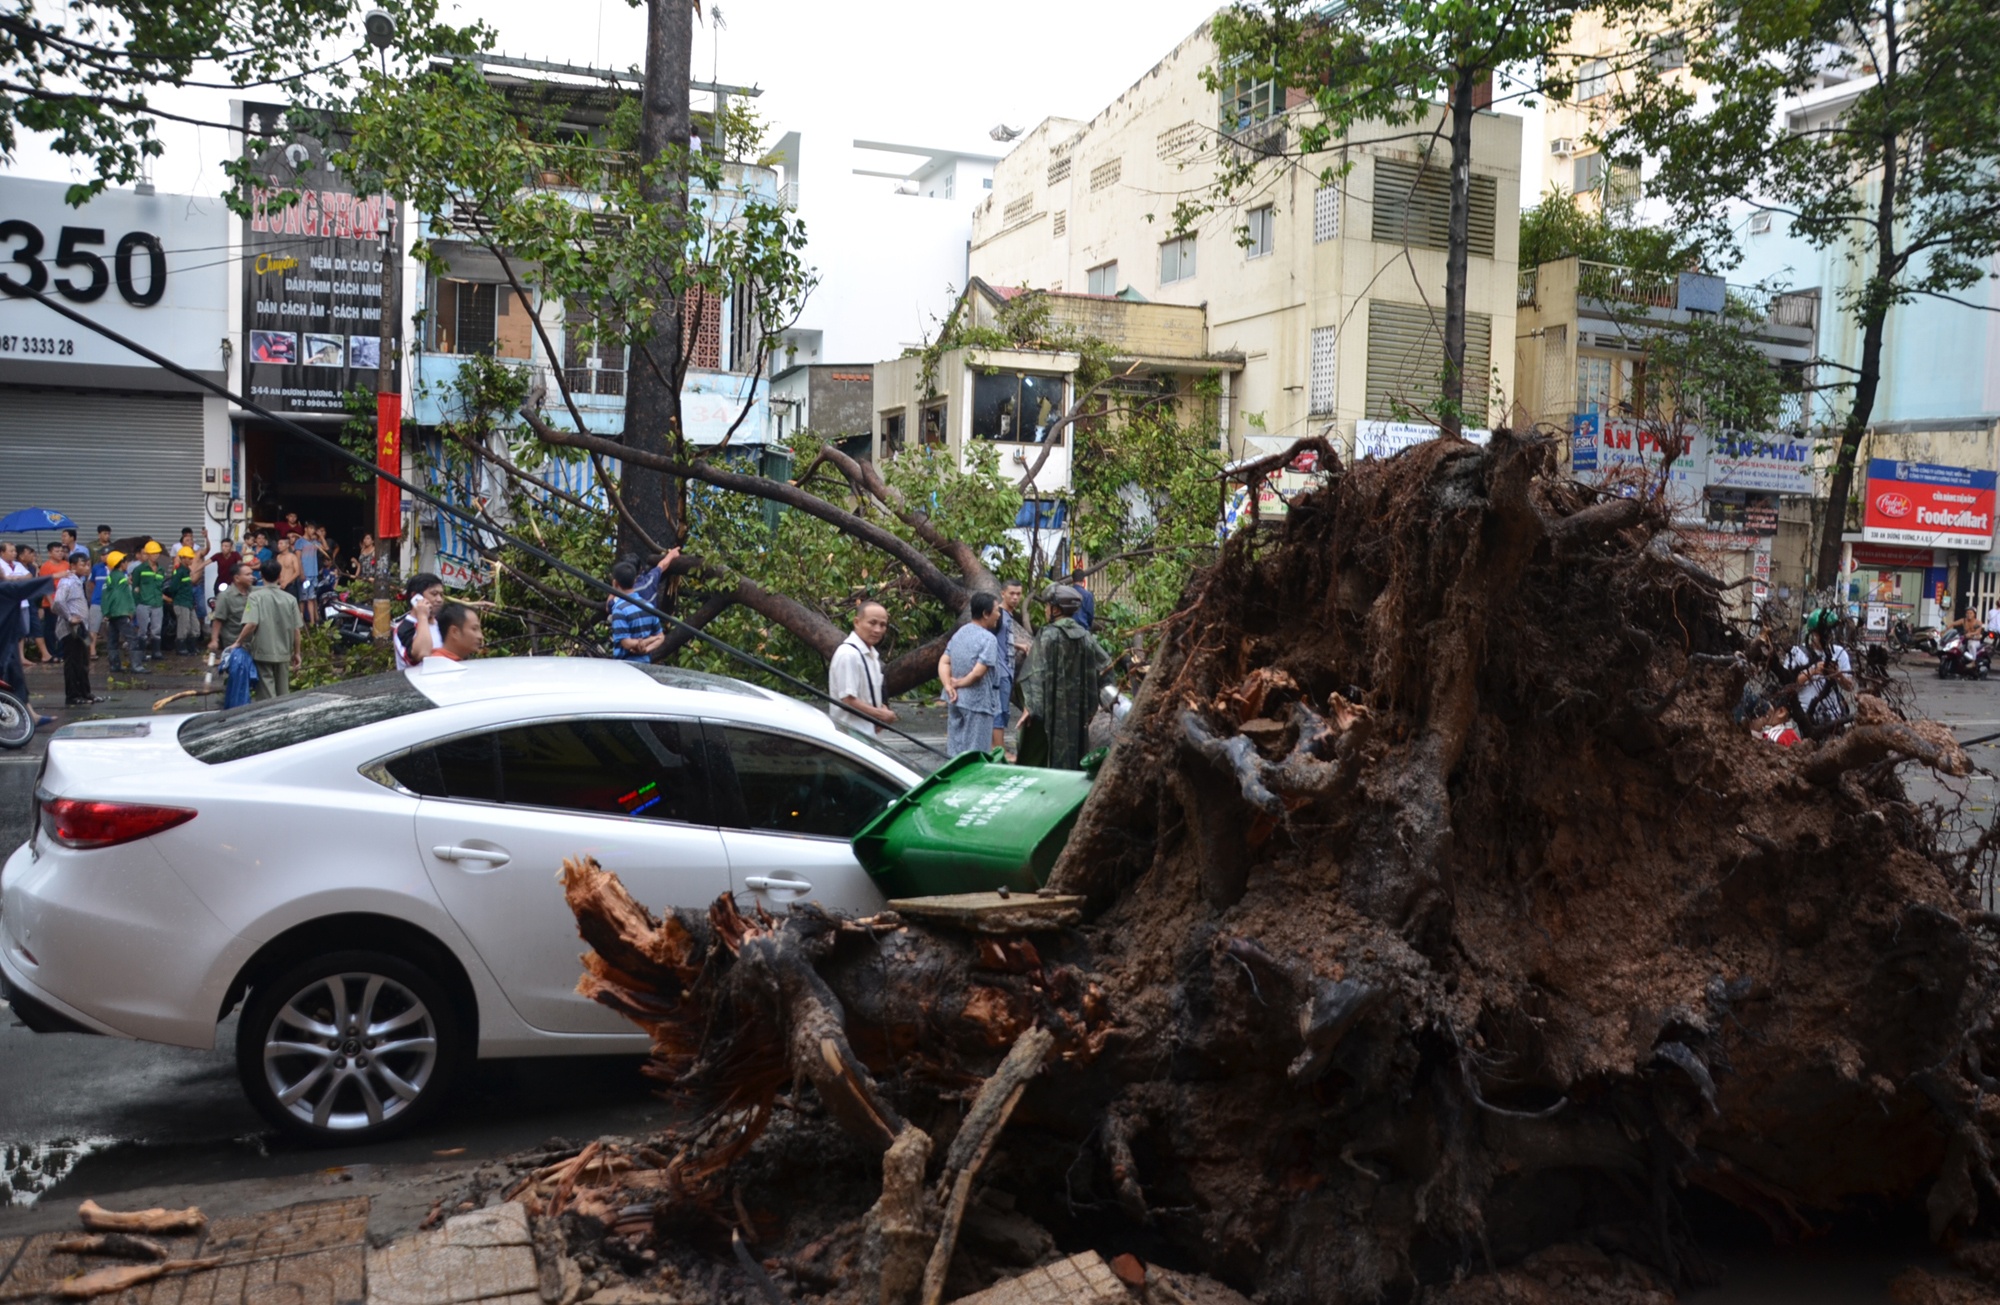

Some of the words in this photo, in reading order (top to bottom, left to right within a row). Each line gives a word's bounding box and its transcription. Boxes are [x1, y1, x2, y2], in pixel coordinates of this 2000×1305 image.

[0, 219, 167, 309] 350
[255, 254, 298, 276] Chuyên:
[310, 255, 332, 272] NỆM
[335, 258, 347, 270] DA
[351, 260, 369, 273] CAO
[285, 277, 306, 292] DÁN
[307, 280, 331, 293] PHIM
[333, 280, 359, 295] CÁCH
[256, 299, 277, 314] DÁN
[280, 300, 307, 316] CÁCH
[310, 302, 325, 317] ÂM
[333, 304, 359, 319] CÁCH
[22, 337, 55, 354] 3333
[58, 339, 74, 356] 28
[250, 386, 269, 395] 344
[281, 388, 307, 397] DƯƠNG
[308, 389, 336, 398] VƯƠNG,
[1363, 430, 1389, 442] CÔNG
[1391, 433, 1403, 444] TY
[1759, 440, 1808, 462] PHÁT
[1916, 506, 1988, 530] FoodcoMart
